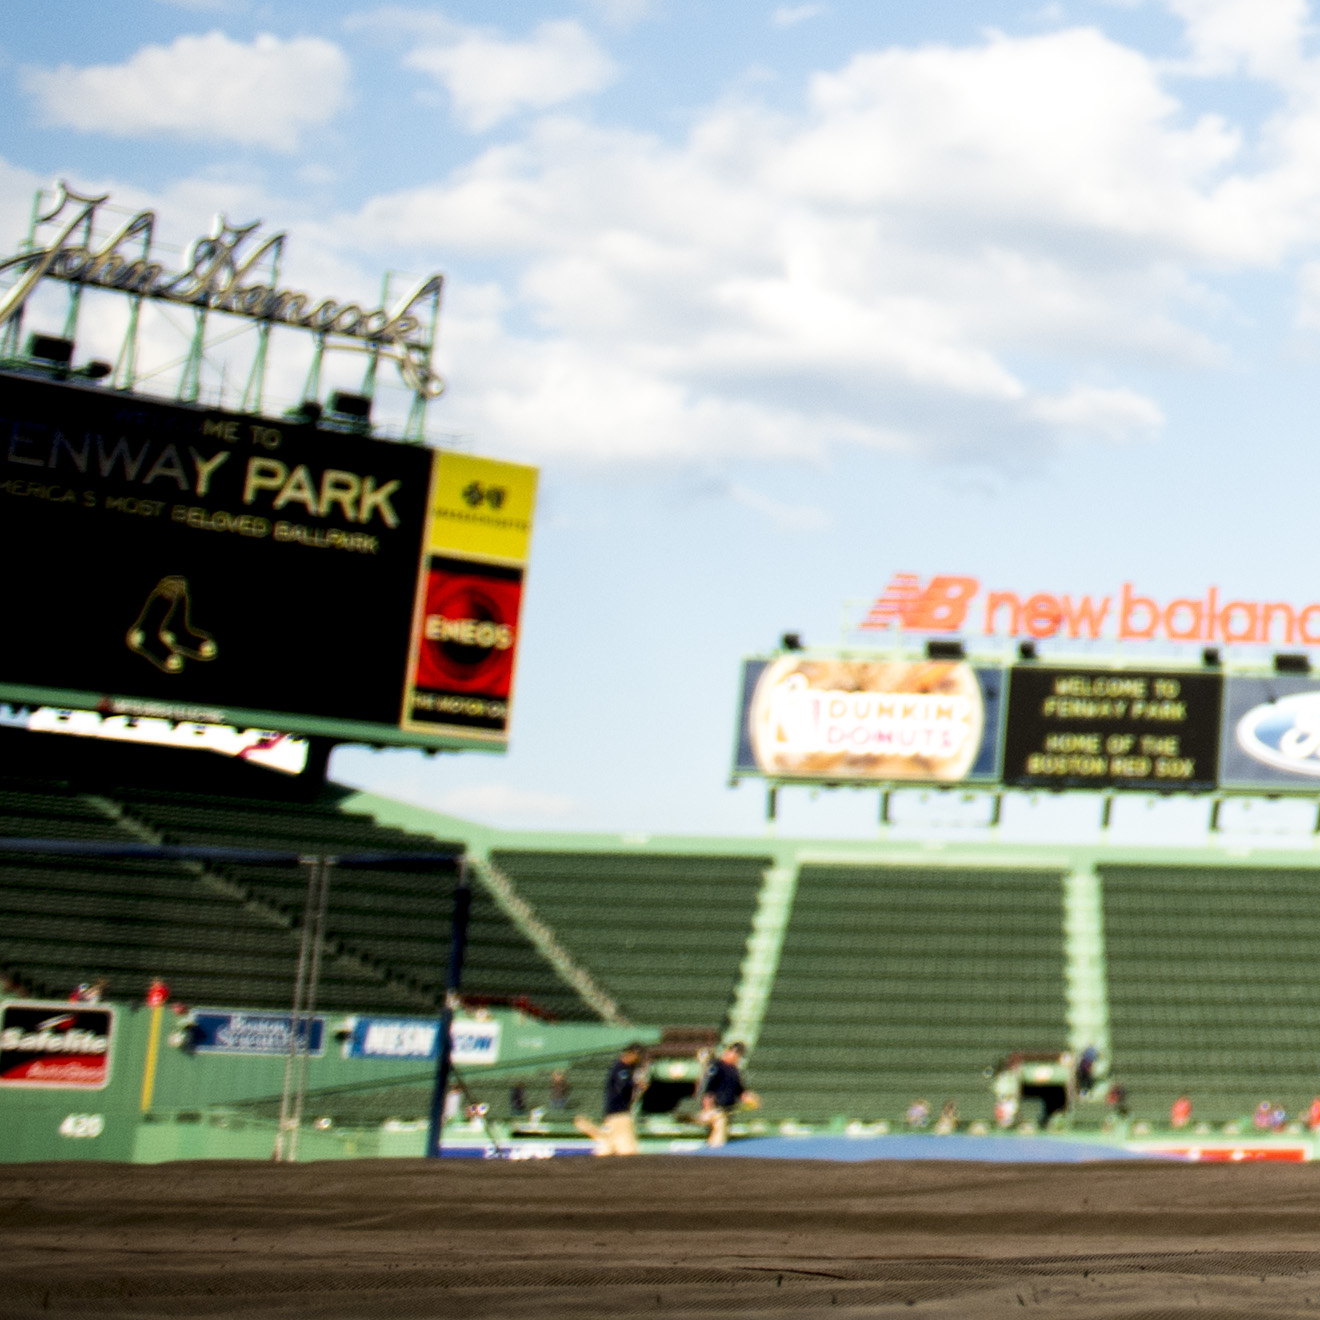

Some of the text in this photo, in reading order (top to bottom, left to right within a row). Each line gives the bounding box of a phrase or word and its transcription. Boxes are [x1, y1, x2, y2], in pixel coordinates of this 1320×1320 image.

[0, 418, 404, 530] ENWAY PARK
[104, 494, 168, 519] MOST
[170, 503, 274, 540] BELOVED
[273, 519, 381, 556] BALLPARK
[984, 590, 1110, 639] new
[424, 613, 516, 651] ENEOS
[1055, 676, 1181, 699] WELCOME TO
[1043, 695, 1187, 720] FENWAY PARK
[827, 725, 952, 747] DONUTS
[1045, 732, 1180, 756] HOME OF THE
[1027, 752, 1196, 778] BOSTON RED SOX
[0, 1026, 107, 1055] Safelite
[58, 1112, 104, 1139] 420
